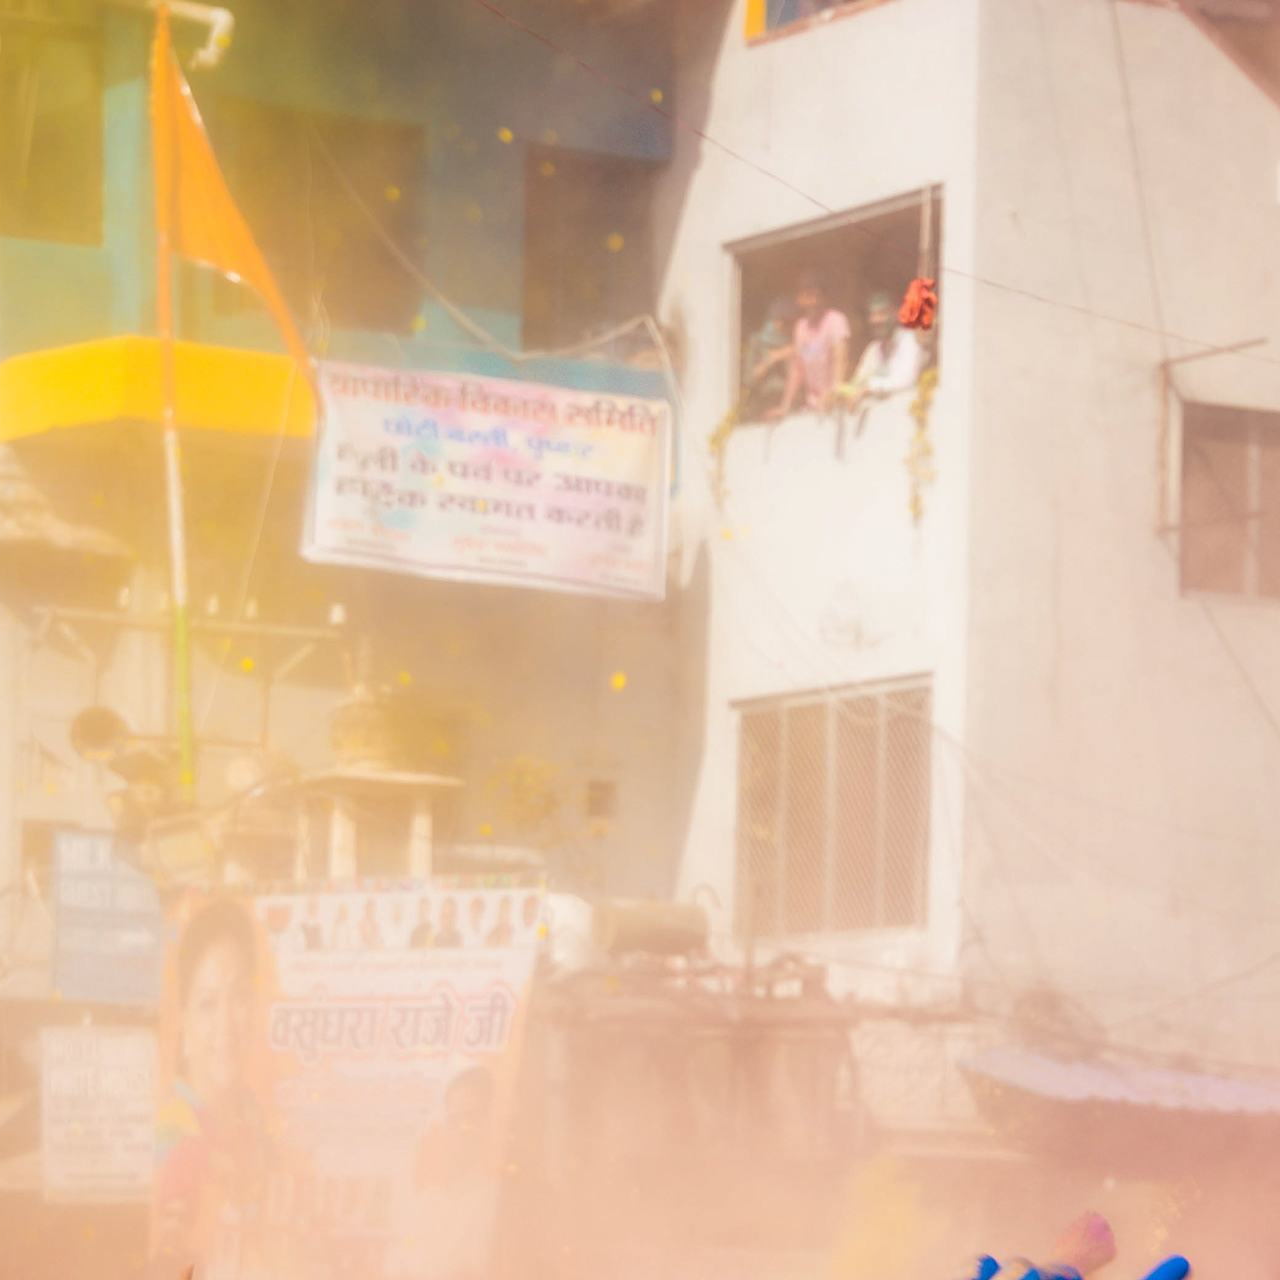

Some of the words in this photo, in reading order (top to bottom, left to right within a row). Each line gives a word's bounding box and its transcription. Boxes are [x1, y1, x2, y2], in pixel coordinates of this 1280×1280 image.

[564, 396, 660, 438] समिति
[271, 993, 381, 1058] वसुंधरा
[389, 990, 455, 1050] राजे
[465, 990, 515, 1050] जी
